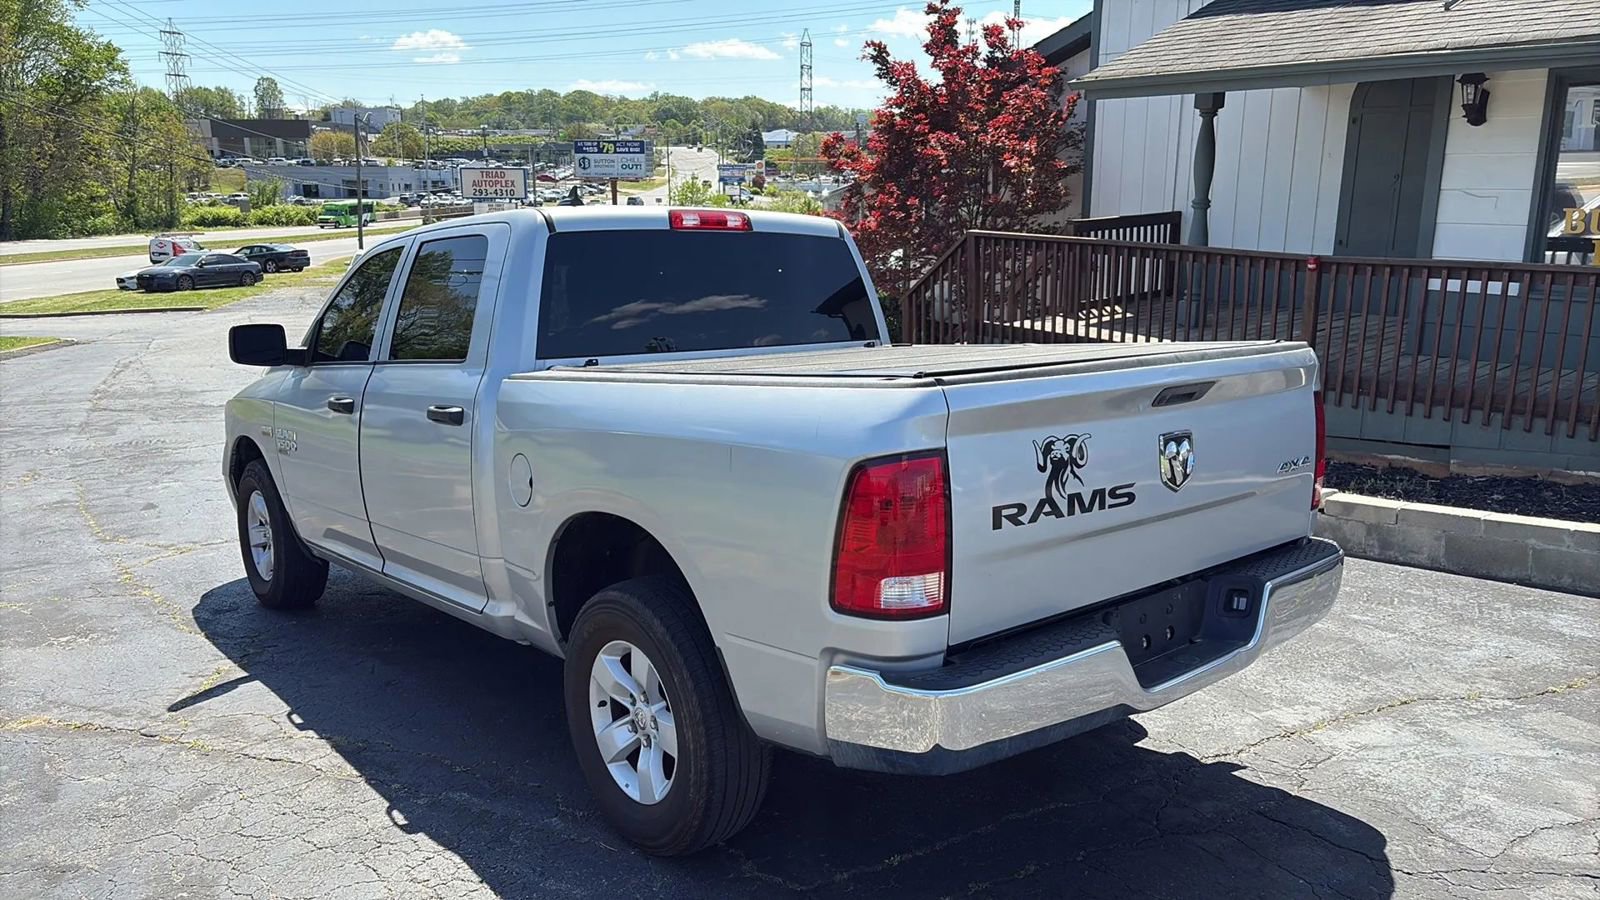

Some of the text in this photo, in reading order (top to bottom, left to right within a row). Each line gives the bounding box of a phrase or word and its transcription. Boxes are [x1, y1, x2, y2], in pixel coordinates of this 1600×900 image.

[600, 141, 614, 153] $79
[480, 171, 505, 179] TRIAD
[472, 180, 515, 188] AUTOPLEX
[472, 188, 515, 197] 293-4310
[992, 482, 1136, 531] RAMS
